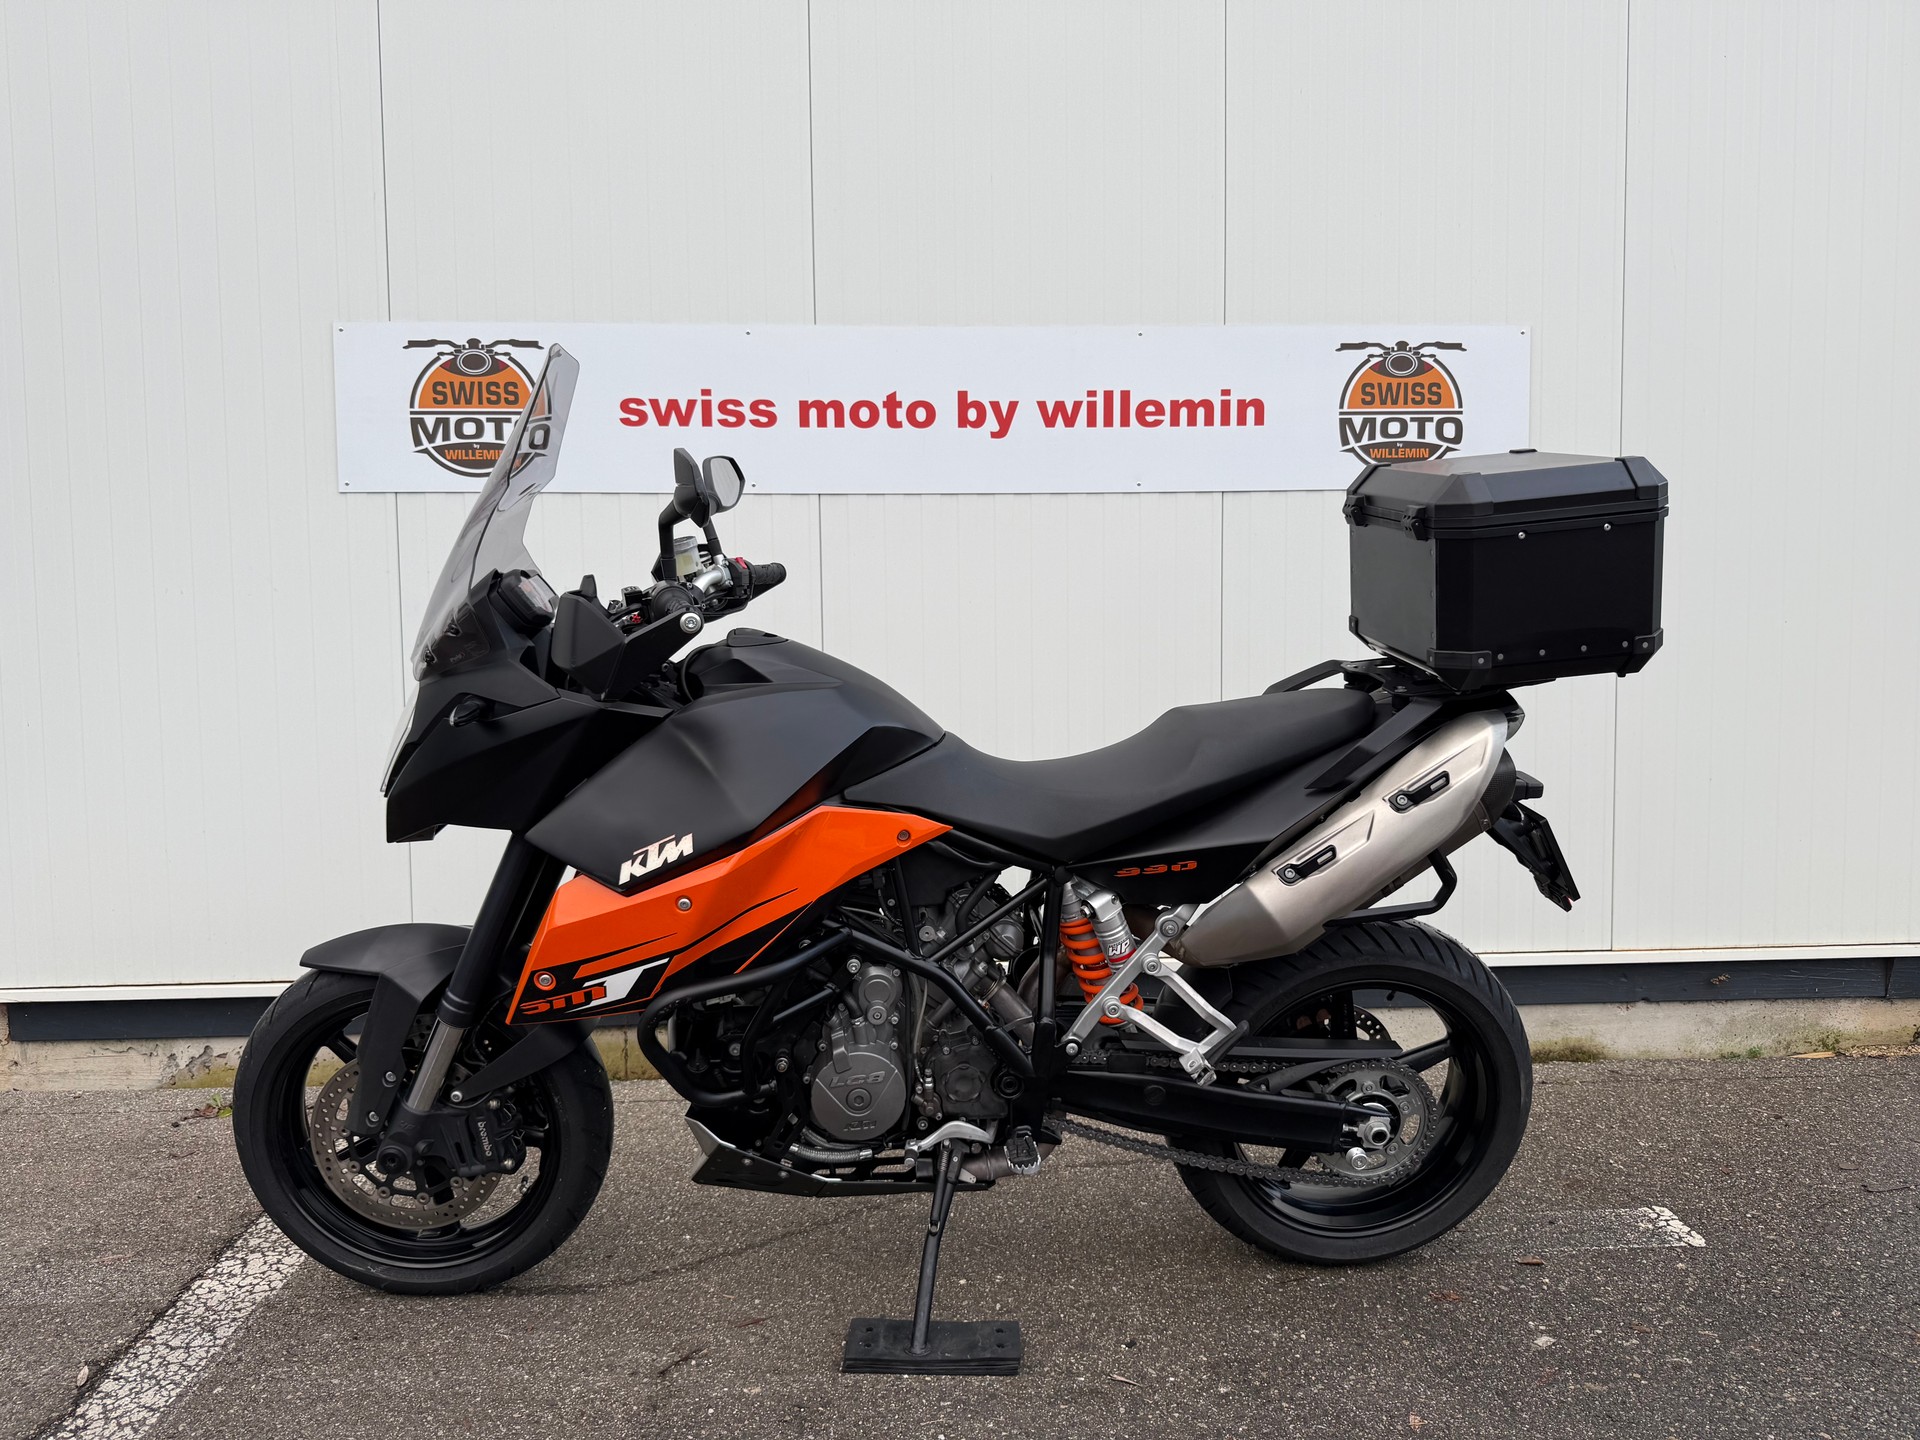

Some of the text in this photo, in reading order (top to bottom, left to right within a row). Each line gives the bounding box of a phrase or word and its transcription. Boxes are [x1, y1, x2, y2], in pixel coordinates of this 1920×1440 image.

[432, 381, 520, 406] SWISS
[1361, 382, 1442, 406] SWISS
[619, 388, 1265, 439] swiss moto by willemin
[1338, 416, 1464, 447] MOTO
[1369, 448, 1430, 459] WILLEMIN
[618, 832, 694, 885] KTM
[1113, 860, 1198, 878] 990
[1108, 938, 1131, 957] WP
[477, 1120, 493, 1157] brembo
